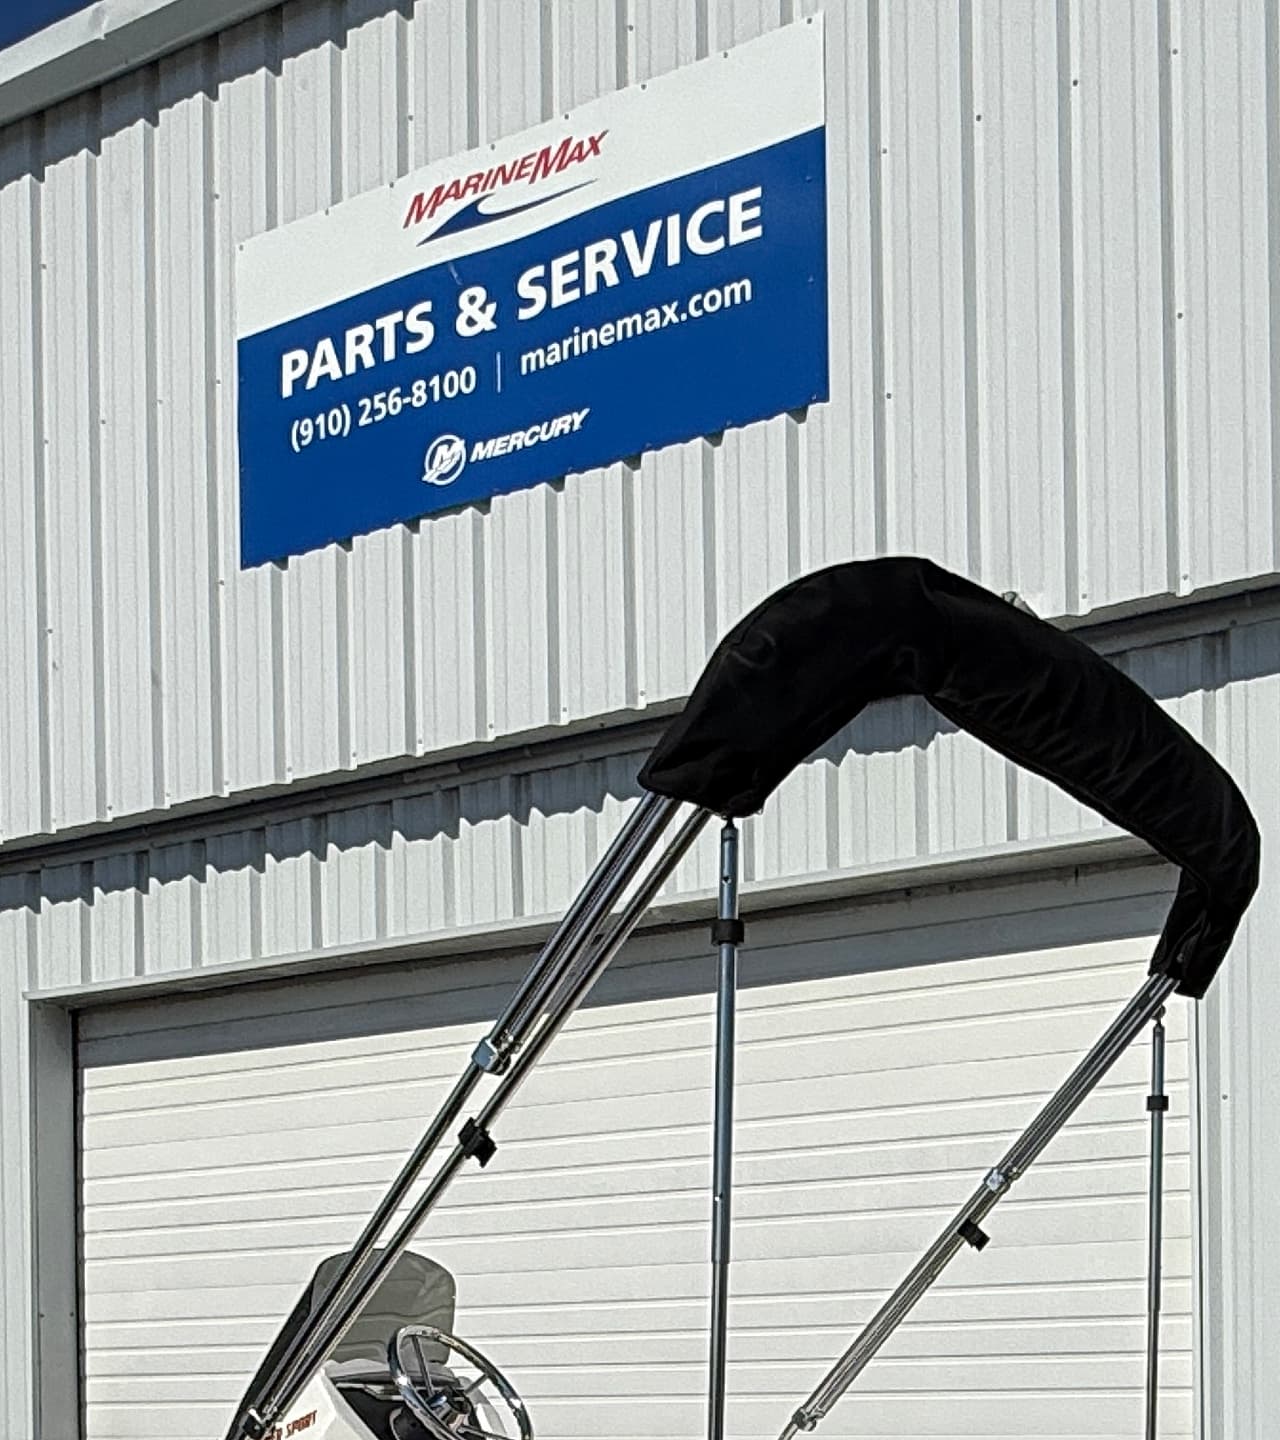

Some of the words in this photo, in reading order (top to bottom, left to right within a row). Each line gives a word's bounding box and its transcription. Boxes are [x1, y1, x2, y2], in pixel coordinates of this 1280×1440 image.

[403, 130, 609, 228] MARINEMAX
[281, 302, 435, 398] PARTS
[457, 286, 497, 337] &
[517, 187, 763, 320] SERVICE
[291, 404, 351, 452] (910)
[358, 367, 476, 427] 256-8100
[521, 278, 752, 375] marinemax.com
[470, 408, 590, 462] MERCURY
